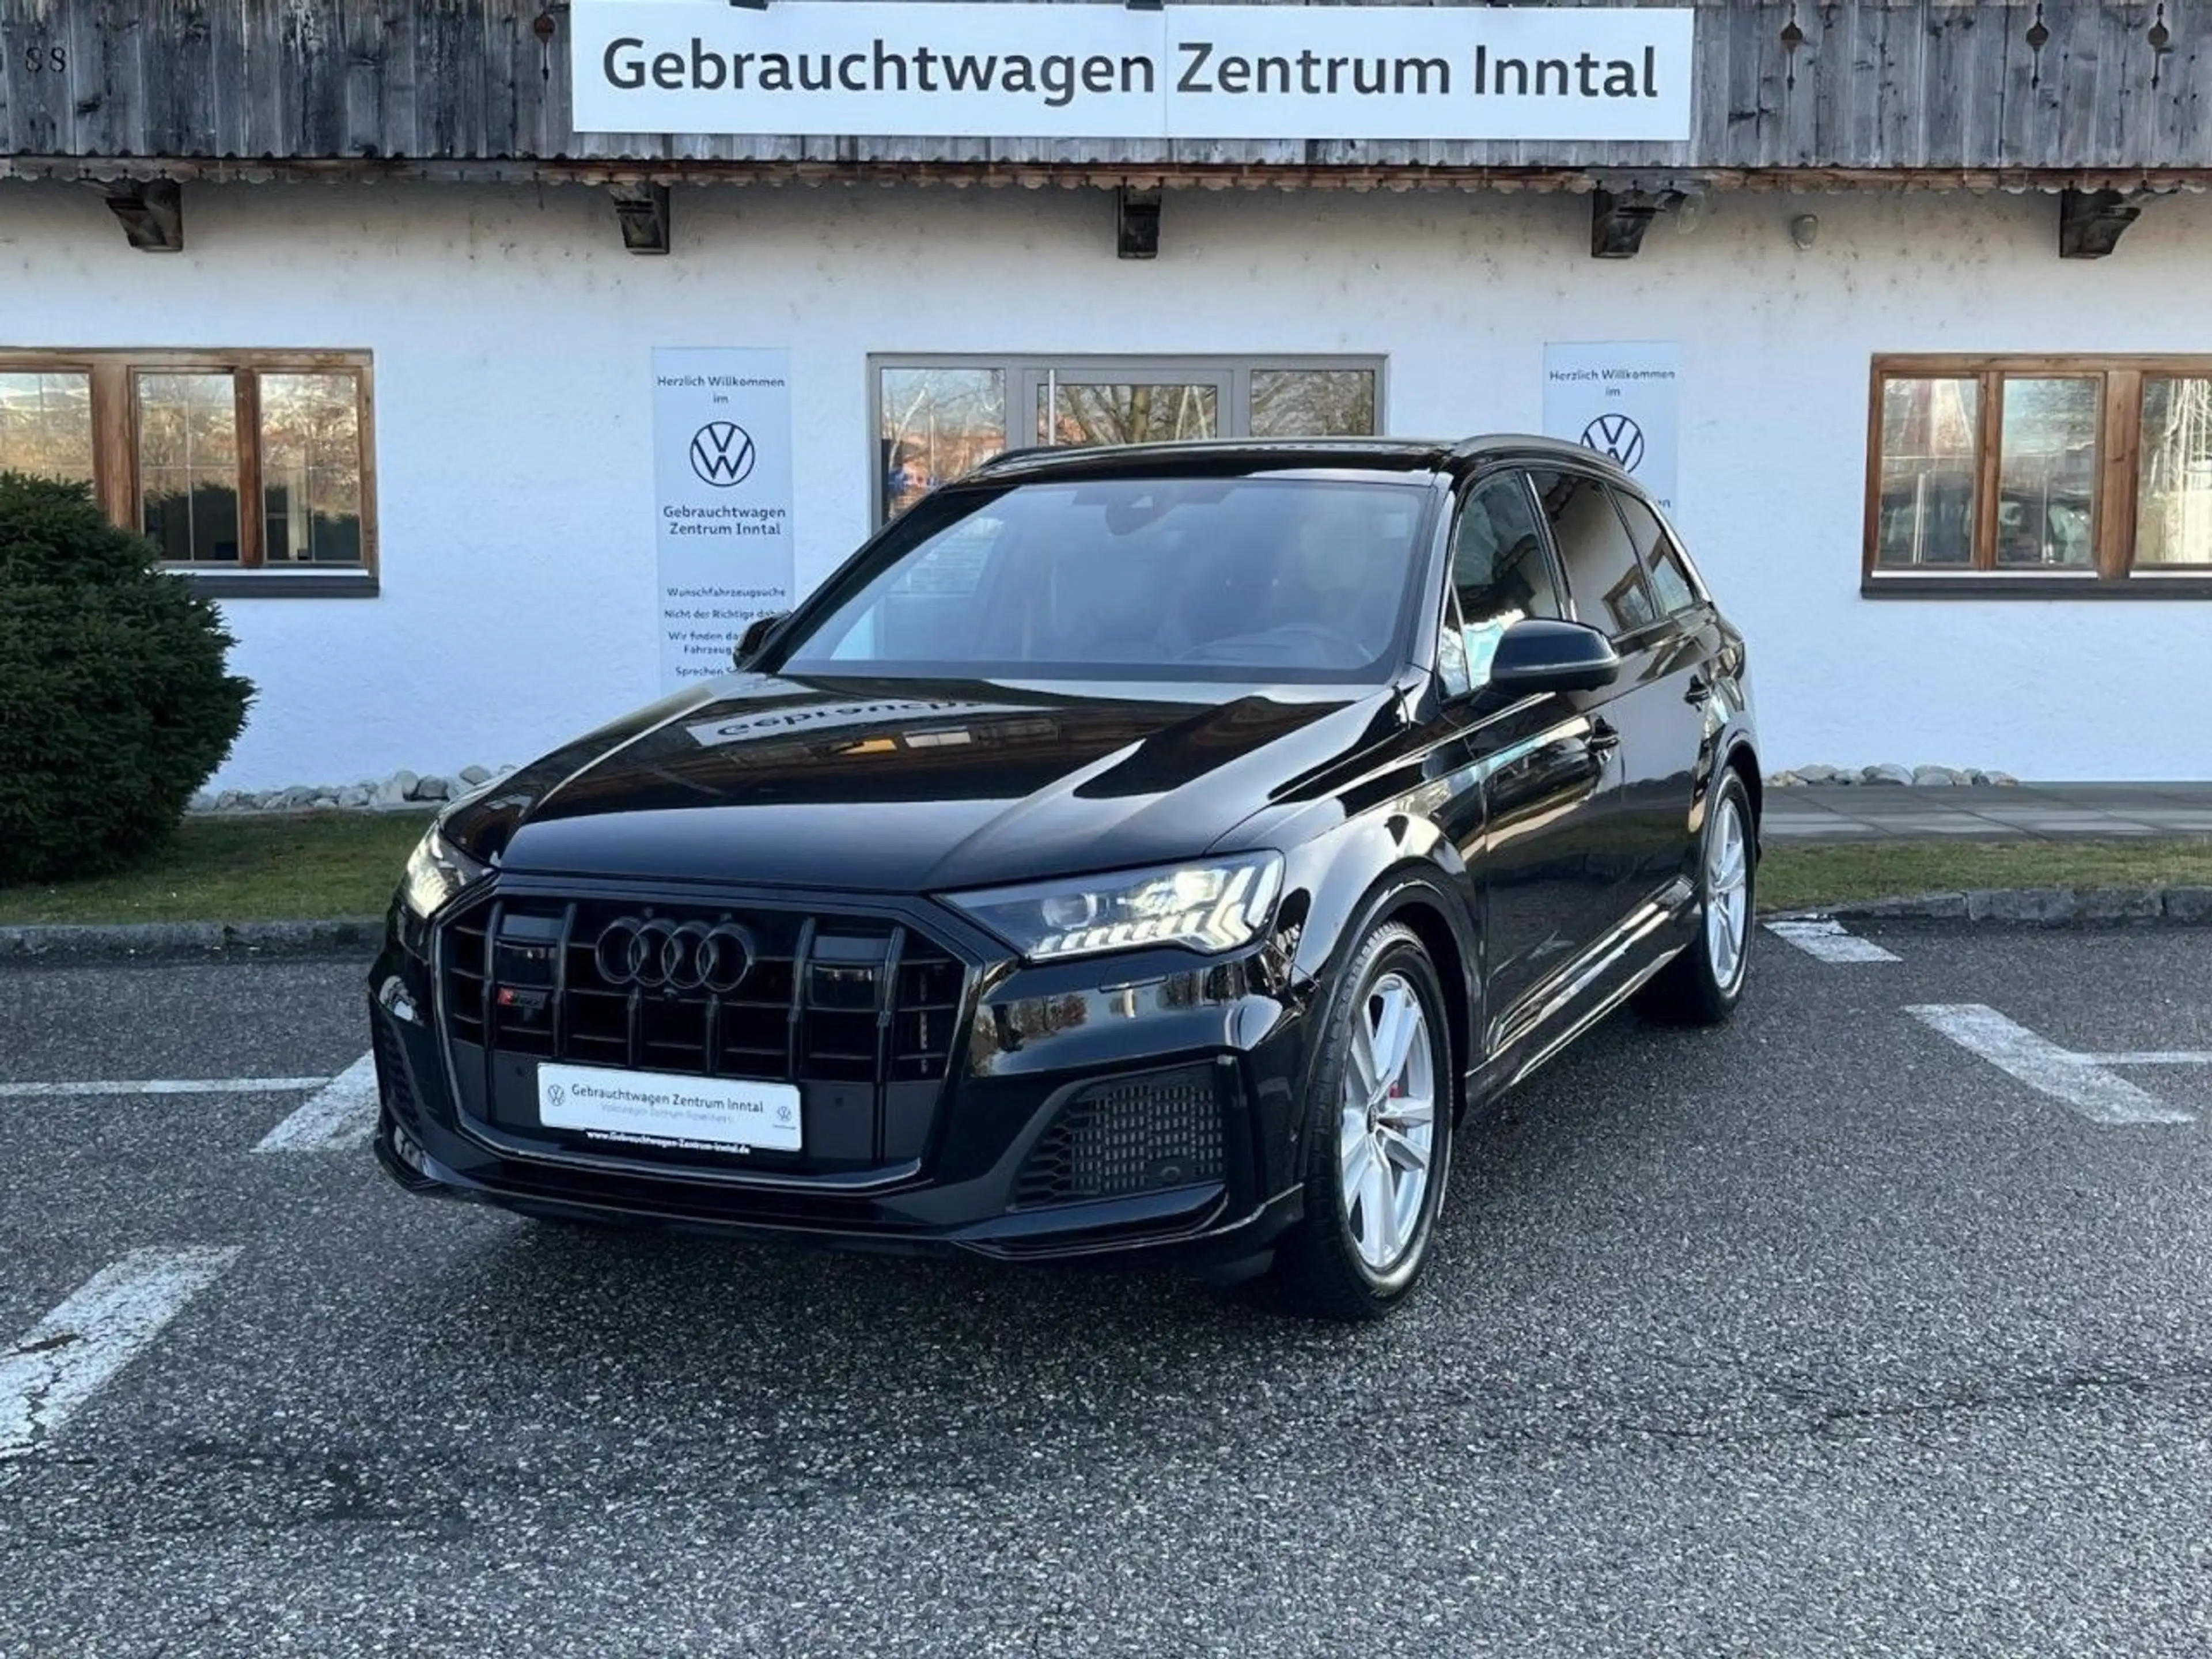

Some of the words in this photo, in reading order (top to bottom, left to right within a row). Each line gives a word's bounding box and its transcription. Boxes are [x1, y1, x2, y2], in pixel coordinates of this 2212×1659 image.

[603, 37, 1154, 107] Gebrauchtwagen
[1176, 43, 1450, 95] Zentrum
[1475, 44, 1657, 97] Inntal
[1550, 370, 1598, 381] Herzlich
[1602, 369, 1675, 380] Willkommen
[657, 376, 704, 387] Herzlich
[708, 376, 785, 387] Willkommen
[1605, 387, 1620, 396] im
[713, 393, 728, 403] im
[664, 505, 786, 522] Gebrauchtwagen
[669, 523, 732, 535] Zentrum
[737, 522, 781, 535] Inntal
[684, 645, 732, 655] Fahrzeug
[571, 1083, 669, 1106] Gebrauchtwagen
[672, 1093, 725, 1109] Zentrum
[727, 1097, 763, 1113] Inntal
